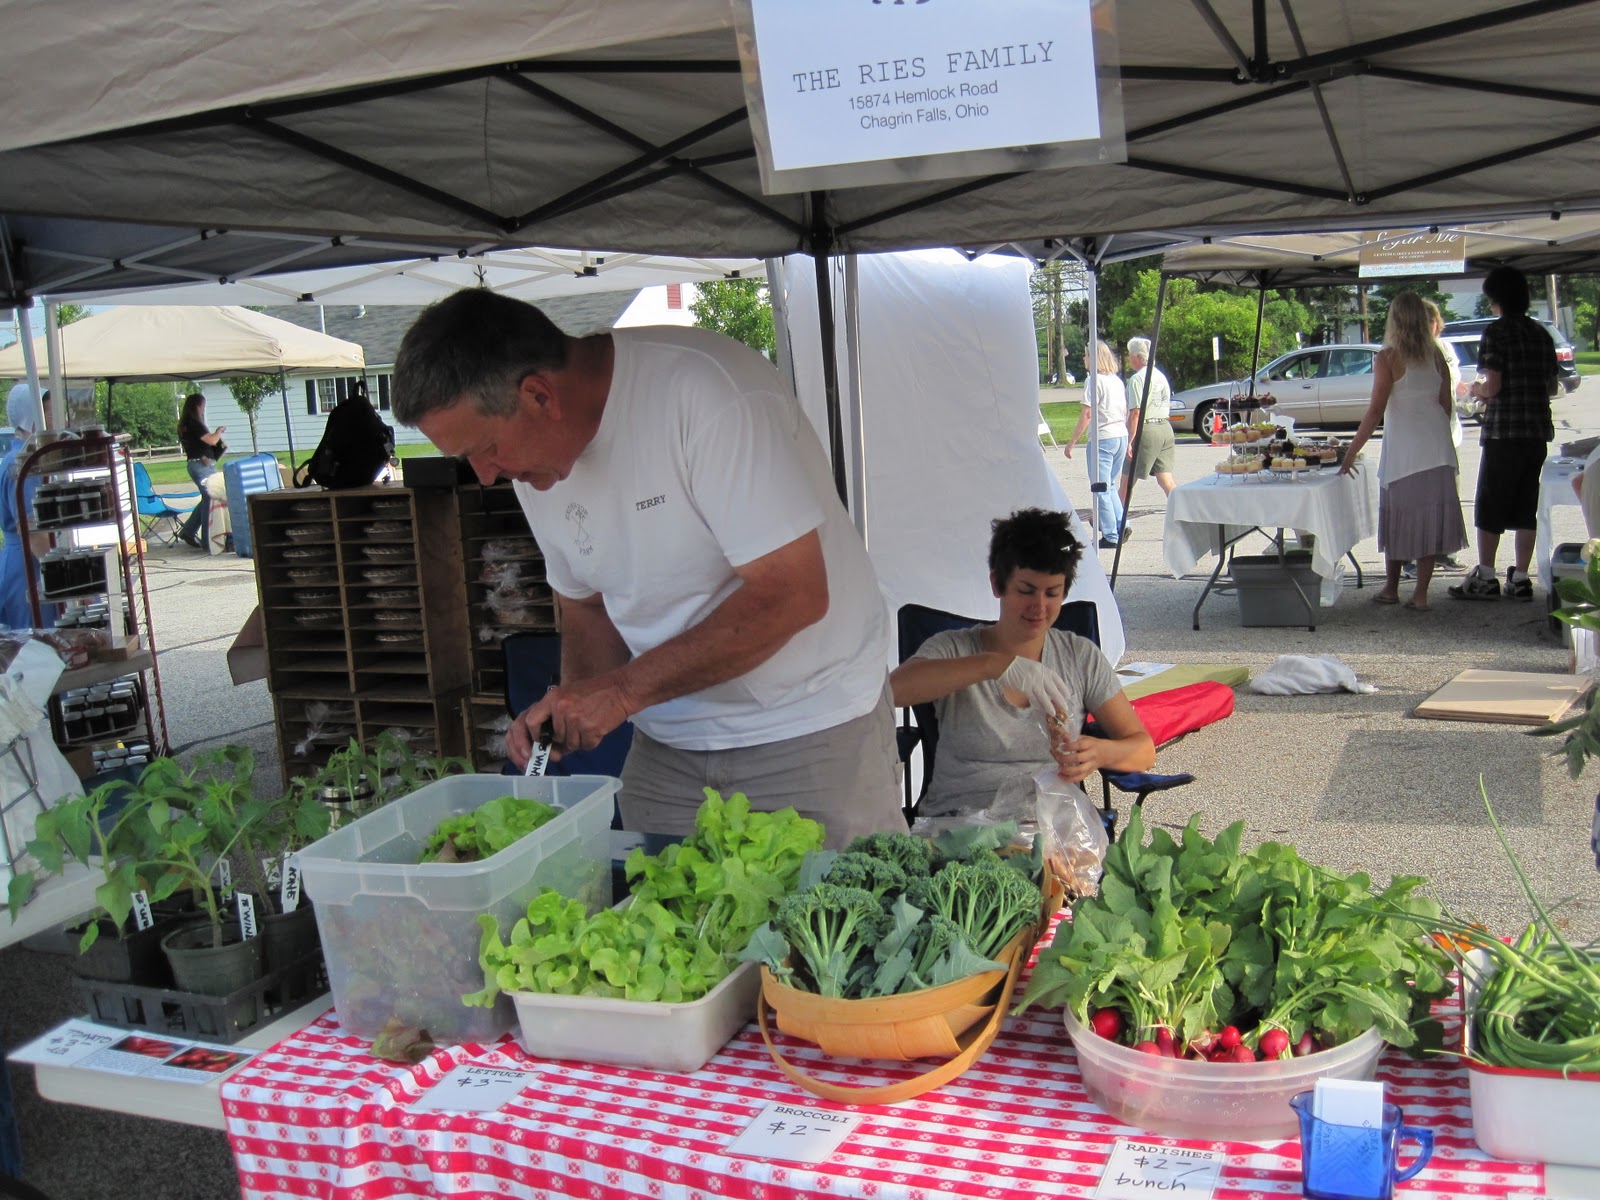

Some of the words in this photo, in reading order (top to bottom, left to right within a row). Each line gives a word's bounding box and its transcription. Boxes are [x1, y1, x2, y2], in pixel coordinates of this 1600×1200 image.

[792, 68, 841, 93] THE
[858, 57, 926, 86] RIES
[946, 41, 1055, 75] FAMILY
[849, 92, 890, 111] 15874
[894, 84, 956, 106] Hemlock
[960, 80, 999, 98] Road
[860, 110, 913, 131] Chagrin
[916, 106, 952, 124] Falls,
[955, 102, 989, 119] Ohio
[636, 494, 666, 511] TERRY
[465, 1067, 526, 1079] LETTUCE
[774, 1106, 850, 1124] BROCCOLI
[1125, 1143, 1213, 1160] RADISHES
[1114, 1172, 1186, 1191] bunch
